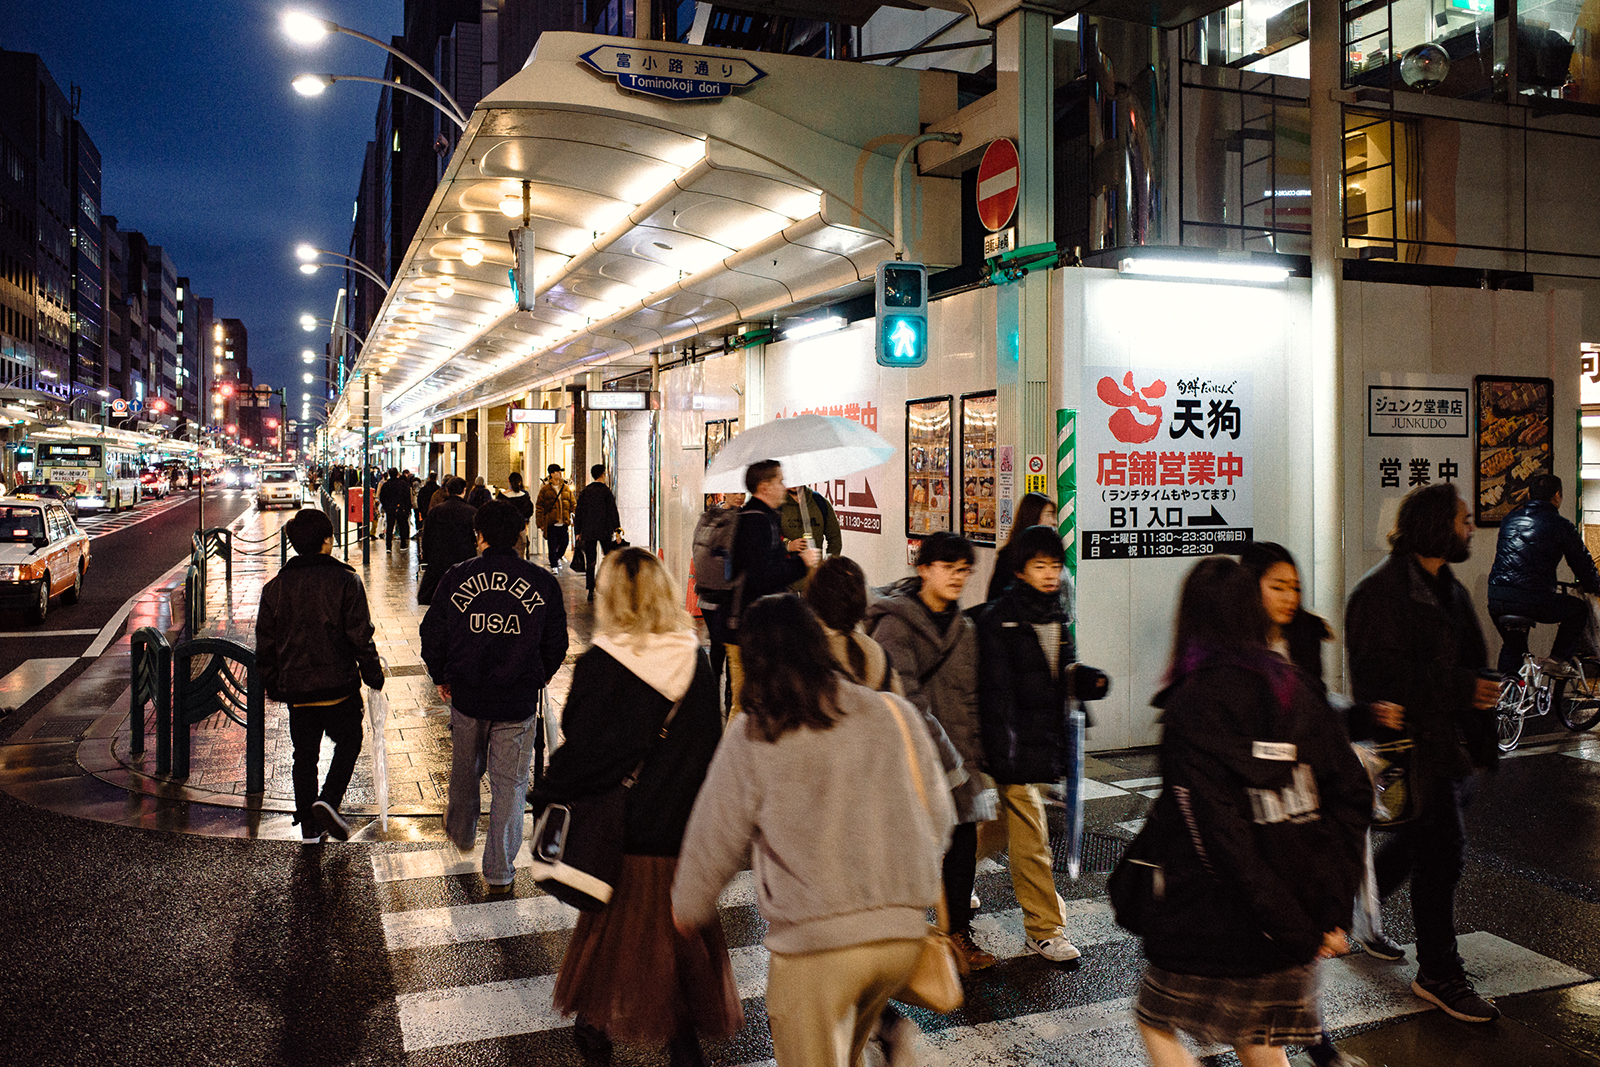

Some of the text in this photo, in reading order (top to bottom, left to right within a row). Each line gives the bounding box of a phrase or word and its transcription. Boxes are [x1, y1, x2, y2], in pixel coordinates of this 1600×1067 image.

[616, 52, 733, 78] 富小路通り
[629, 74, 720, 94] Tominokoji dori
[1375, 396, 1462, 414] ジュンク堂書店
[1169, 399, 1241, 440] 天狗
[1392, 417, 1447, 429] JUNKUDO
[1096, 450, 1243, 486] 店舗営業中
[1379, 457, 1459, 488] 営業中
[1101, 489, 1236, 502] (ランチタイムもやってます)
[1110, 507, 1183, 528] B1 入口
[1142, 544, 1214, 555] 11:30〜22:30
[450, 571, 546, 614] AVIREX
[469, 613, 521, 635] USA
